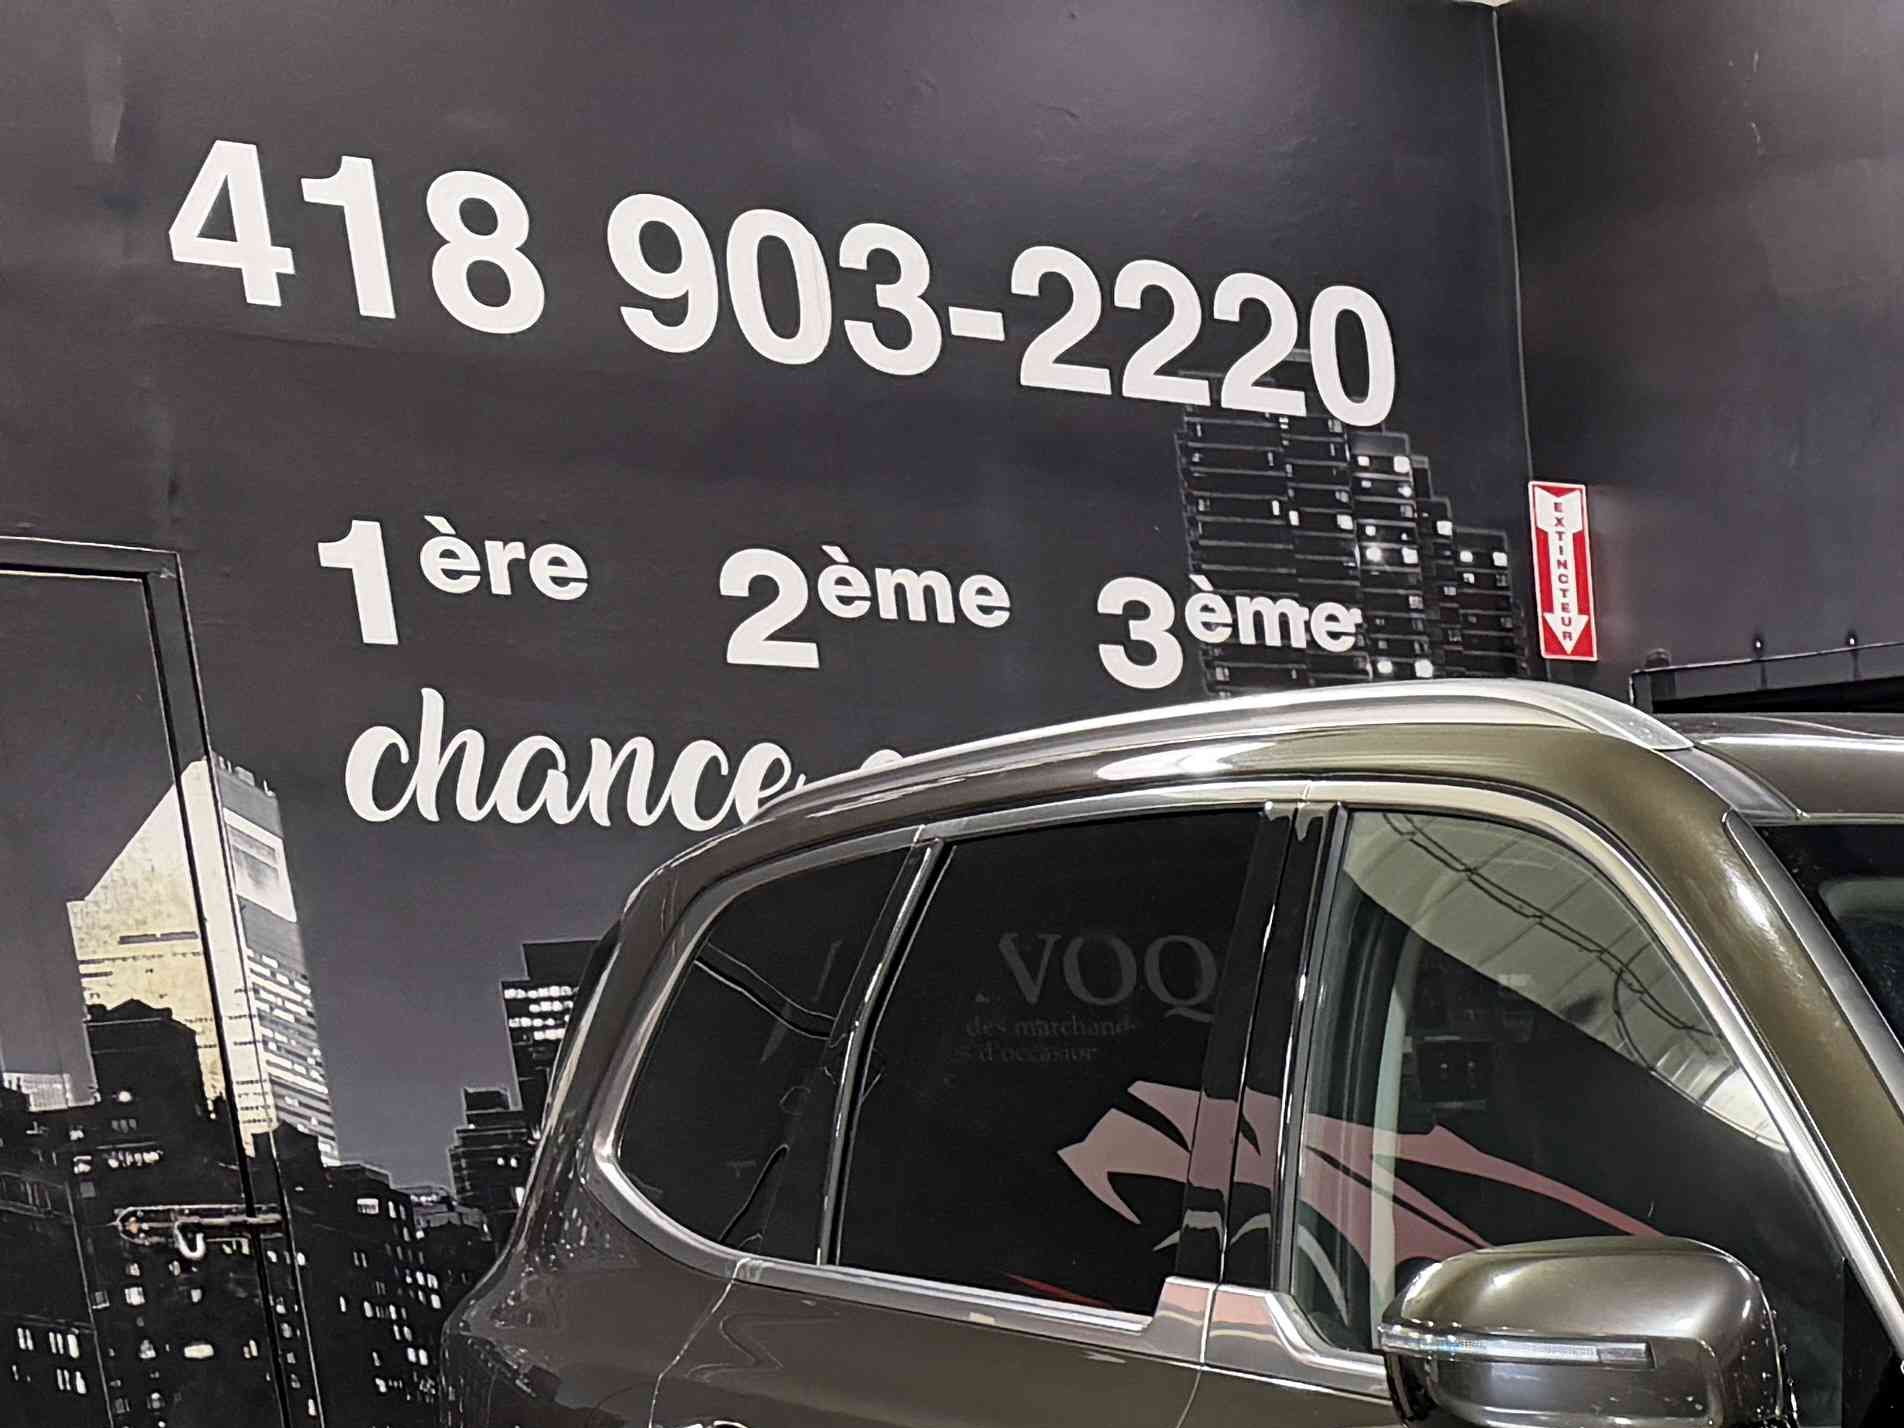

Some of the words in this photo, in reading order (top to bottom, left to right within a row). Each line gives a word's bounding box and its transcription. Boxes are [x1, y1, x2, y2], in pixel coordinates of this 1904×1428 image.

[168, 139, 545, 335] 418
[607, 193, 1396, 427] 903-2220
[317, 515, 588, 645] 1ère
[719, 544, 1011, 669] 2ème
[1097, 573, 1363, 689] 3ème
[1553, 501, 1574, 642] EXTINCTEUR
[344, 687, 806, 832] chance
